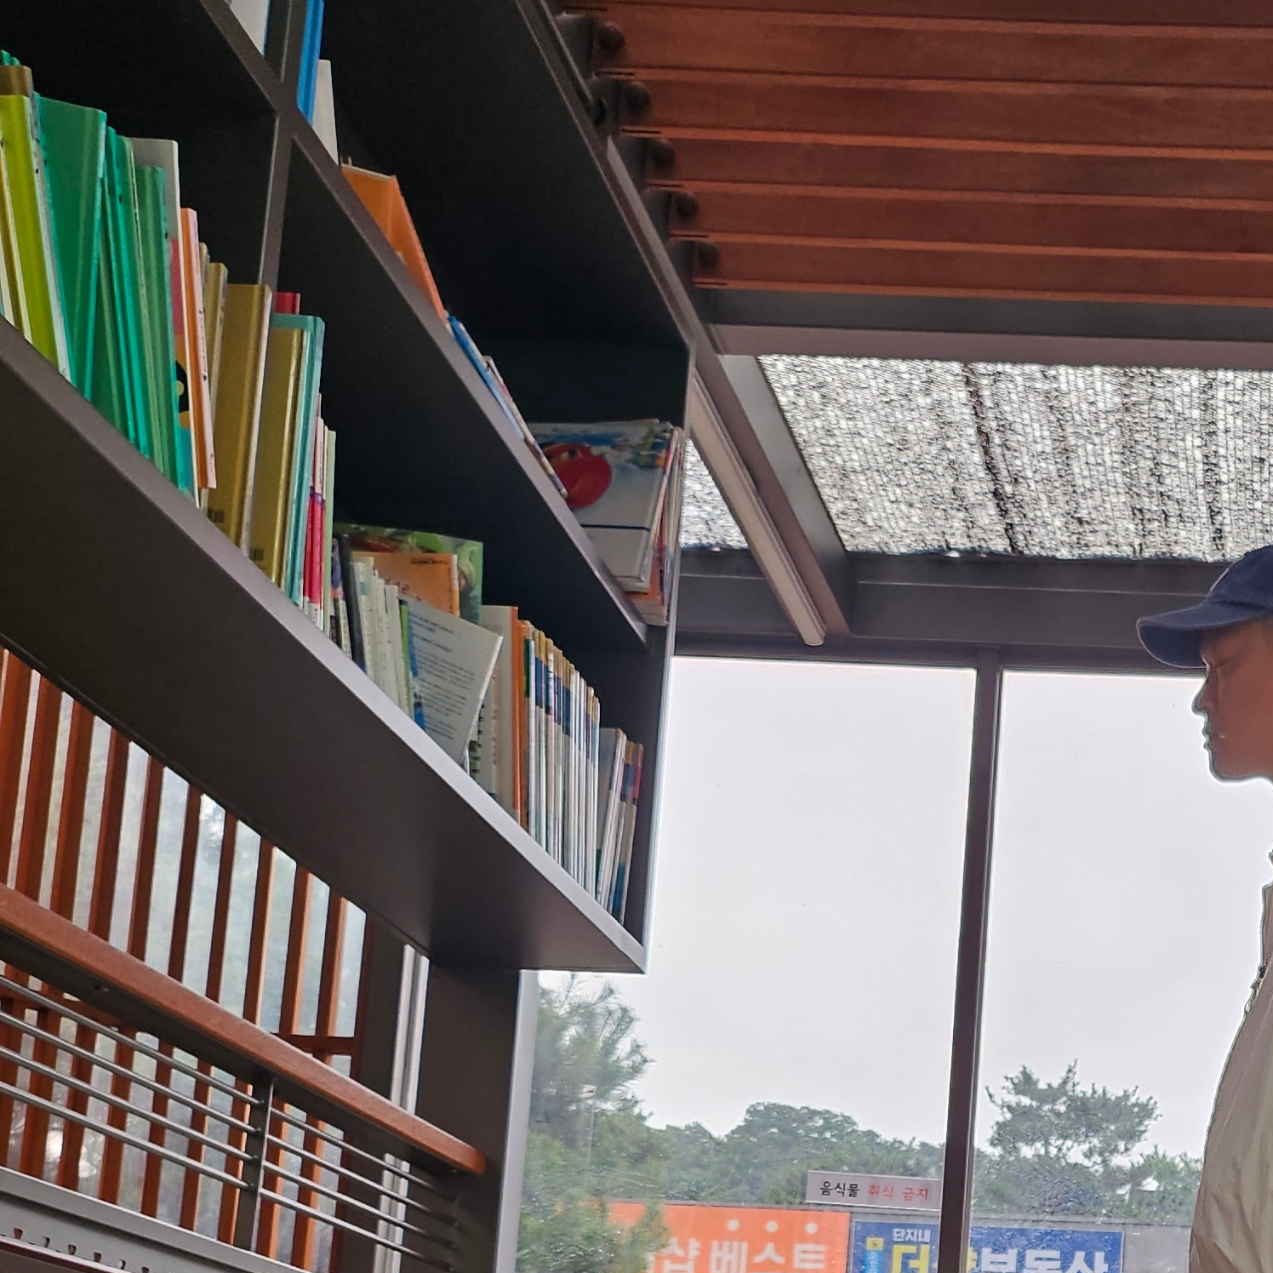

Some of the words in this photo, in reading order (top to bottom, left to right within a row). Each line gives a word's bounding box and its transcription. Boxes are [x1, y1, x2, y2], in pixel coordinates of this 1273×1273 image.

[819, 1180, 860, 1198] 음식물
[902, 1187, 928, 1201] 금지
[893, 1228, 931, 1243] 단지내
